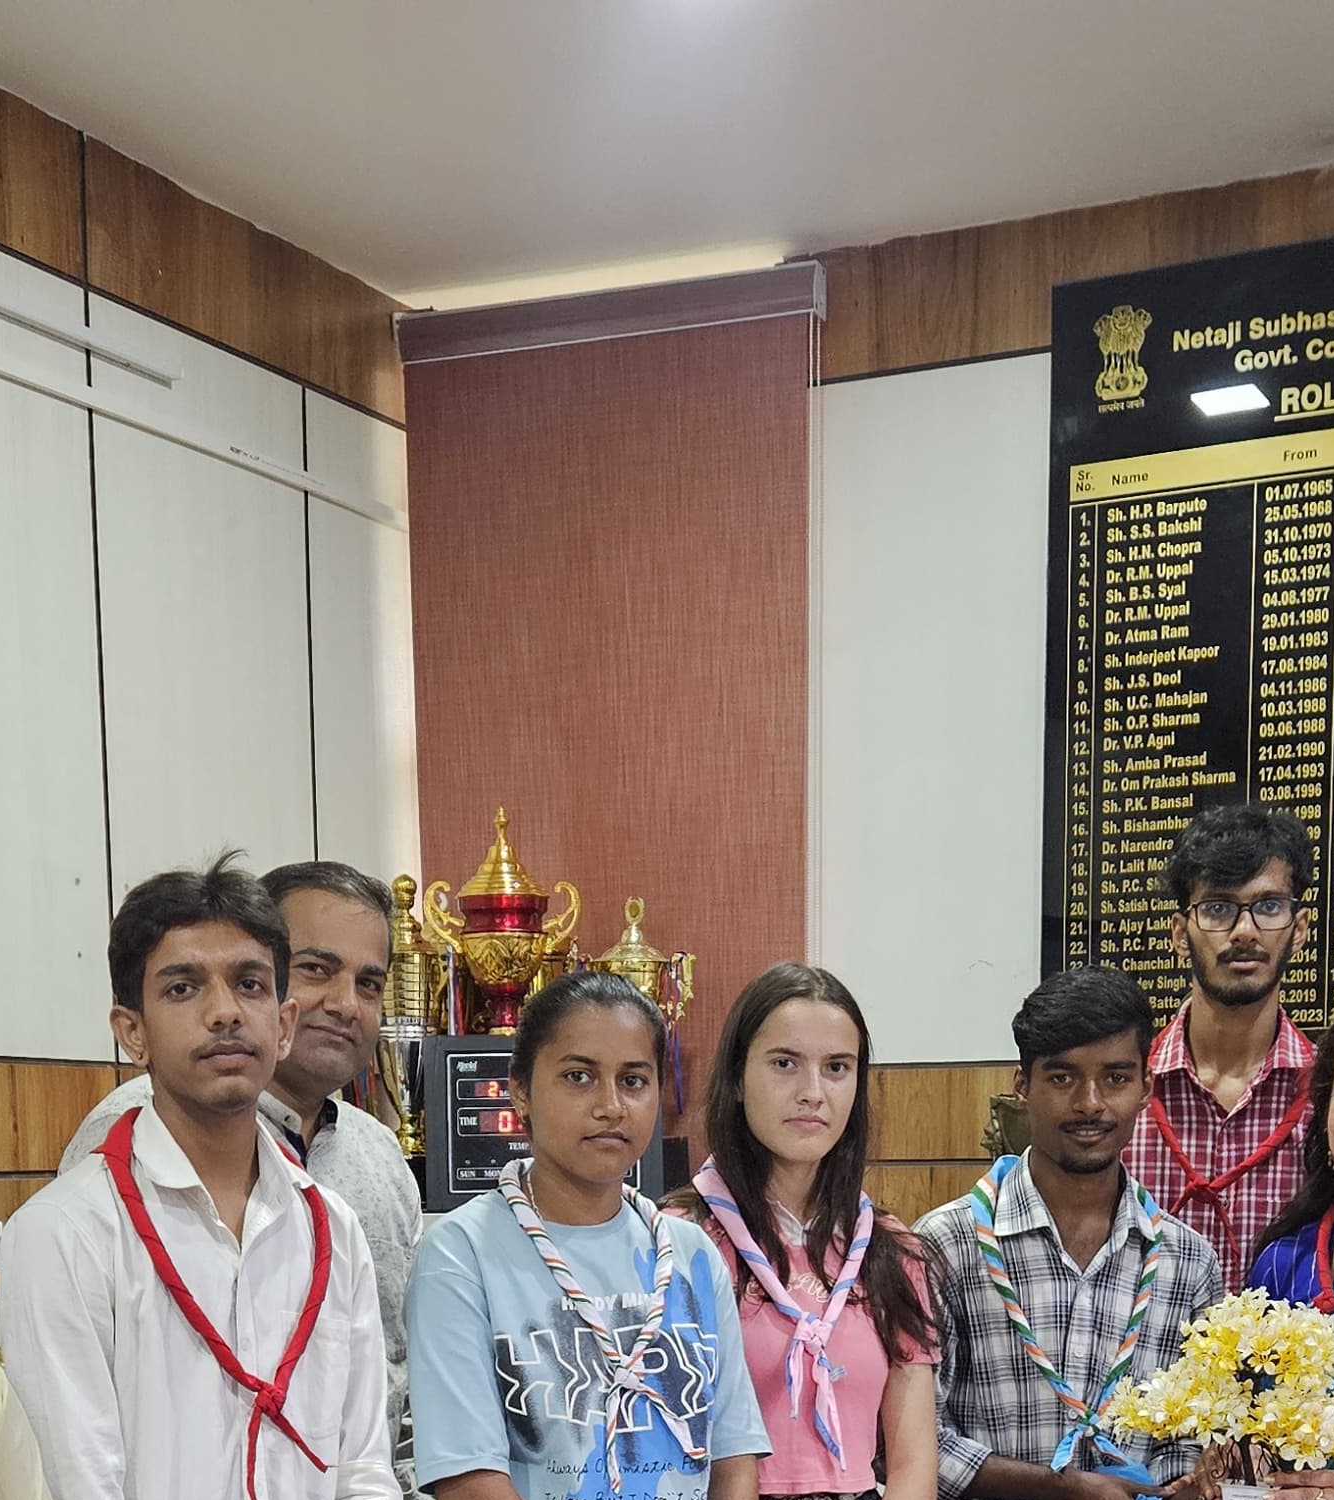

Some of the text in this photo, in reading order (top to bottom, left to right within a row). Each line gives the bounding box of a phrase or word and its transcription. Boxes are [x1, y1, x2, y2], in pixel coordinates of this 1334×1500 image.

[1173, 320, 1241, 352] Netaji
[1234, 345, 1298, 373] Govt.
[1077, 469, 1094, 481] Sr.
[1111, 472, 1149, 486] Name
[1282, 449, 1318, 462] From
[1075, 482, 1095, 493] No.
[1079, 512, 1091, 527] 1.
[1107, 507, 1127, 523] Sh.
[1130, 503, 1154, 521] H.P.
[1157, 497, 1207, 517] Barpute
[1265, 478, 1333, 502] 01.07.1965
[1079, 533, 1091, 547] 2.
[1106, 527, 1126, 543] Sh.
[1130, 523, 1155, 539] S.S.
[1158, 516, 1202, 536] Bakshi
[1264, 500, 1332, 523] 25.05.1968
[1079, 553, 1091, 568] 3.
[1106, 547, 1126, 564] Sh.
[1128, 543, 1155, 561] H.N.
[1157, 539, 1202, 560] Chopra
[1264, 521, 1332, 544] 31.10.1970
[1078, 573, 1090, 588] 4.
[1106, 569, 1123, 584] Dr.
[1126, 565, 1153, 582] R.M.
[1156, 560, 1193, 580] Uppal
[1263, 542, 1331, 565] 05.10.1973
[1078, 592, 1090, 607] 5.
[1105, 588, 1126, 604] Sh.
[1129, 584, 1155, 601] B.S.
[1158, 580, 1186, 600] Syal
[1263, 563, 1331, 586] 15.03.1974
[1078, 585, 1330, 628] 6. Dr. R.M. Uppal 04.08.1977
[1077, 635, 1089, 650] 7.
[1105, 631, 1122, 646] Dr.
[1125, 627, 1158, 644] Atma
[1161, 624, 1190, 640] Ram
[1261, 607, 1329, 630] 29.01.1980
[1077, 658, 1089, 673] 8.
[1104, 653, 1123, 669] Sh.
[1125, 646, 1176, 667] Inderjeet
[1178, 644, 1220, 663] Kapoor
[1261, 630, 1329, 652] 19.01.1983
[1077, 680, 1089, 695] 9.
[1104, 676, 1123, 692] Sh.
[1127, 673, 1151, 689] J.S.
[1153, 669, 1182, 687] Deol
[1260, 653, 1328, 676] 17.08.1984
[1073, 701, 1091, 716] 10.
[1104, 698, 1123, 713] Sh.
[1126, 694, 1153, 711] U.C.
[1155, 690, 1208, 708] Mahajan
[1260, 676, 1328, 698] 04.11.1986
[1073, 720, 1091, 735] 11.
[1103, 718, 1123, 733] Sh.
[1126, 714, 1150, 730] O.P.
[1152, 711, 1201, 728] Sharma
[1260, 697, 1327, 718] 10.03.1988
[1073, 741, 1090, 756] 12.
[1103, 737, 1121, 752] Dr.
[1123, 733, 1145, 749] V.P.
[1147, 730, 1176, 749] Agni
[1259, 717, 1326, 738] 09.06.1988
[1072, 761, 1090, 776] 13.
[1103, 759, 1122, 775] Sh.
[1125, 756, 1161, 772] Amba
[1163, 750, 1208, 768] Prasad
[1258, 741, 1326, 761] 21.02.1990
[1072, 782, 1090, 797] 14.
[1102, 778, 1117, 793] Dr.
[1120, 776, 1140, 792] Om
[1142, 773, 1189, 790] Prakash
[1191, 770, 1236, 786] Sharma
[1258, 762, 1325, 782] 17.04.1993
[1071, 801, 1089, 816] 15.
[1102, 799, 1122, 815] Sh.
[1124, 796, 1148, 812] P.K.
[1151, 793, 1194, 811] Bansal
[1259, 782, 1323, 801] 03.08.1996
[1101, 820, 1121, 835] Sh.
[1101, 840, 1117, 855] Dr.
[1120, 837, 1175, 854] Narendra
[1101, 860, 1117, 875] Dr.
[1119, 857, 1145, 874] Lalit
[1100, 880, 1119, 895] Sh.
[1122, 878, 1144, 893] P.C.
[1100, 899, 1116, 915] Sh.
[1118, 898, 1148, 913] Satish
[1100, 919, 1116, 934] Dr.
[1118, 918, 1144, 936] Ajay
[1100, 938, 1119, 954] Sh.
[1122, 936, 1145, 952] P.C.
[1122, 956, 1175, 972] Chanchal
[1156, 975, 1187, 993] Singh
[487, 1081, 499, 1097] 2
[459, 1116, 478, 1126] TIME
[460, 1170, 476, 1178] SUN
